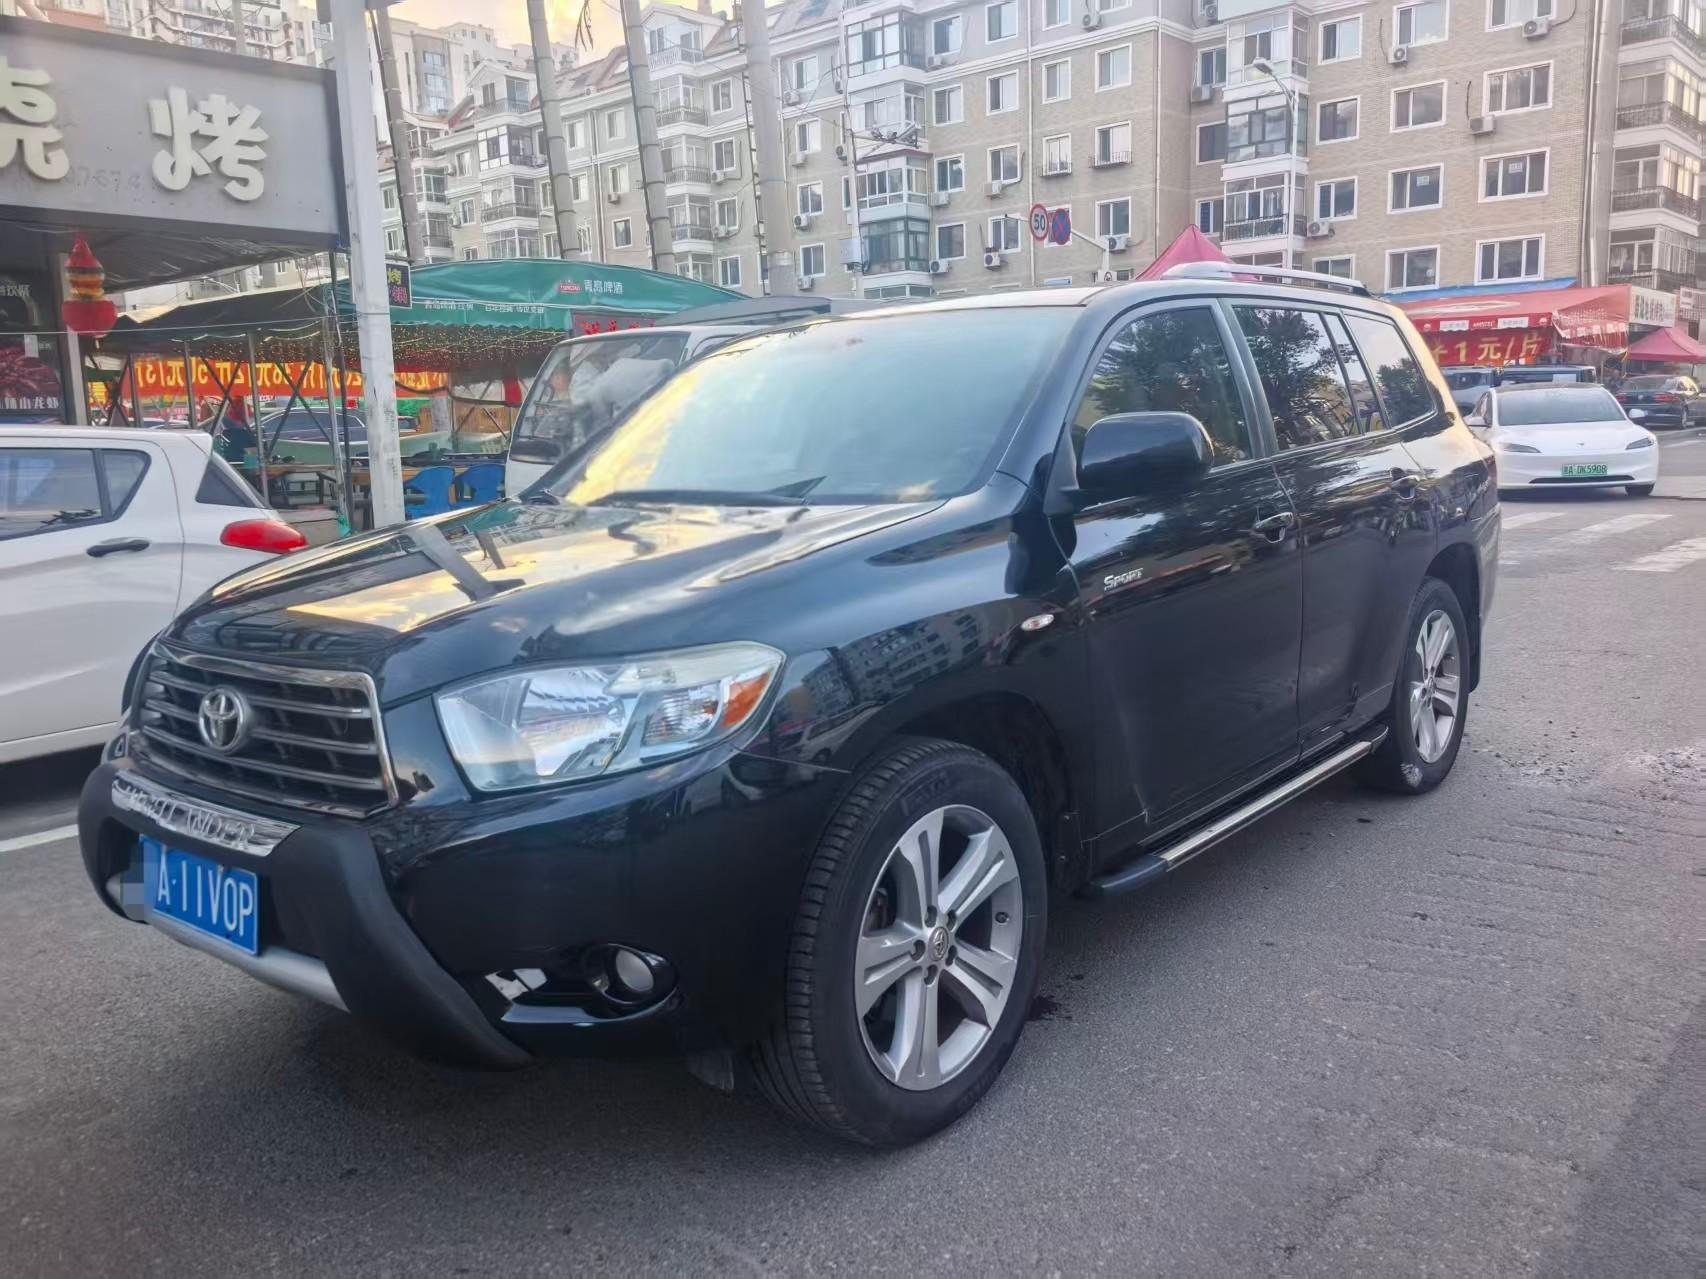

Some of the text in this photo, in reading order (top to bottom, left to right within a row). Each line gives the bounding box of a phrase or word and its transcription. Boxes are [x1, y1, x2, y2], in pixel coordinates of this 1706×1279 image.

[1033, 213, 1046, 231] 50
[584, 279, 624, 295] 青岛啤酒
